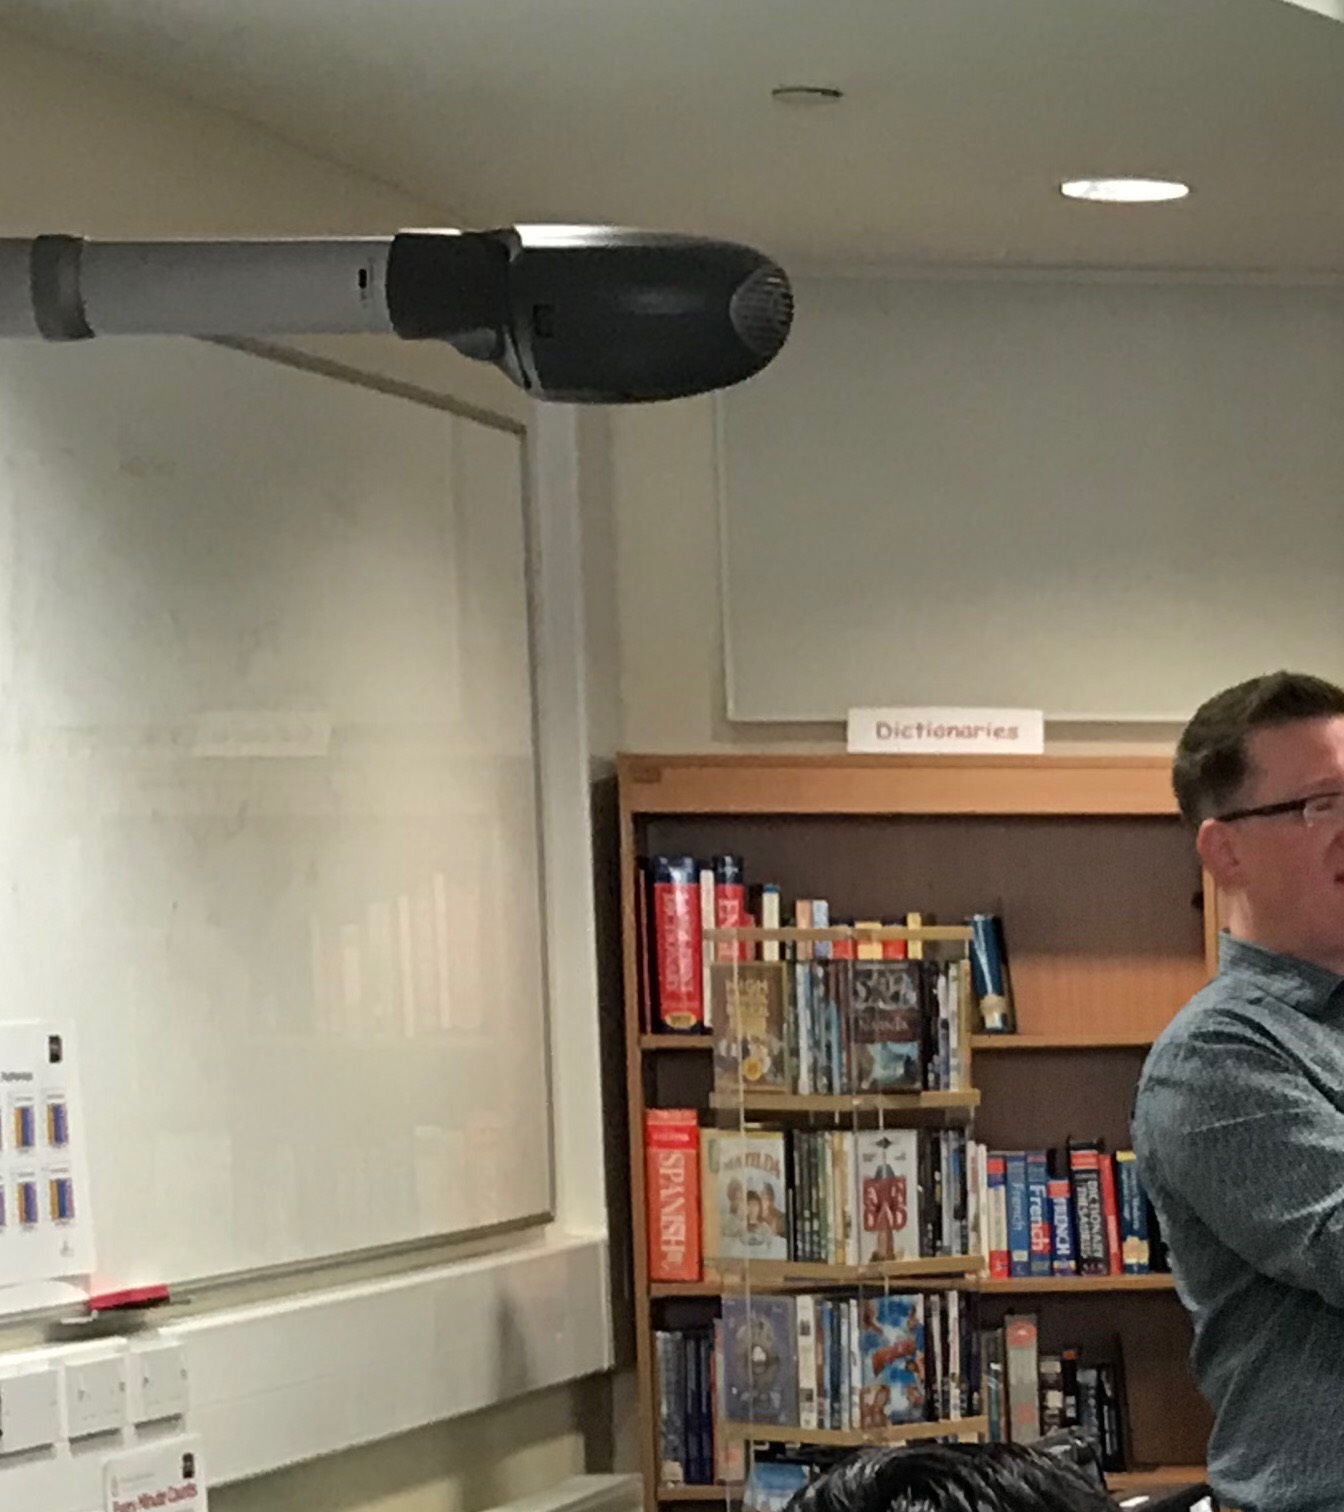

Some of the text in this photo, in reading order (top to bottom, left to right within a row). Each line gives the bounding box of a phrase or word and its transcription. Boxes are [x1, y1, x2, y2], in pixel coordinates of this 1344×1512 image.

[875, 721, 1020, 740] Dictionaries
[659, 1152, 686, 1252] SPANISH
[1011, 1182, 1026, 1231] French
[1029, 1184, 1049, 1251] French
